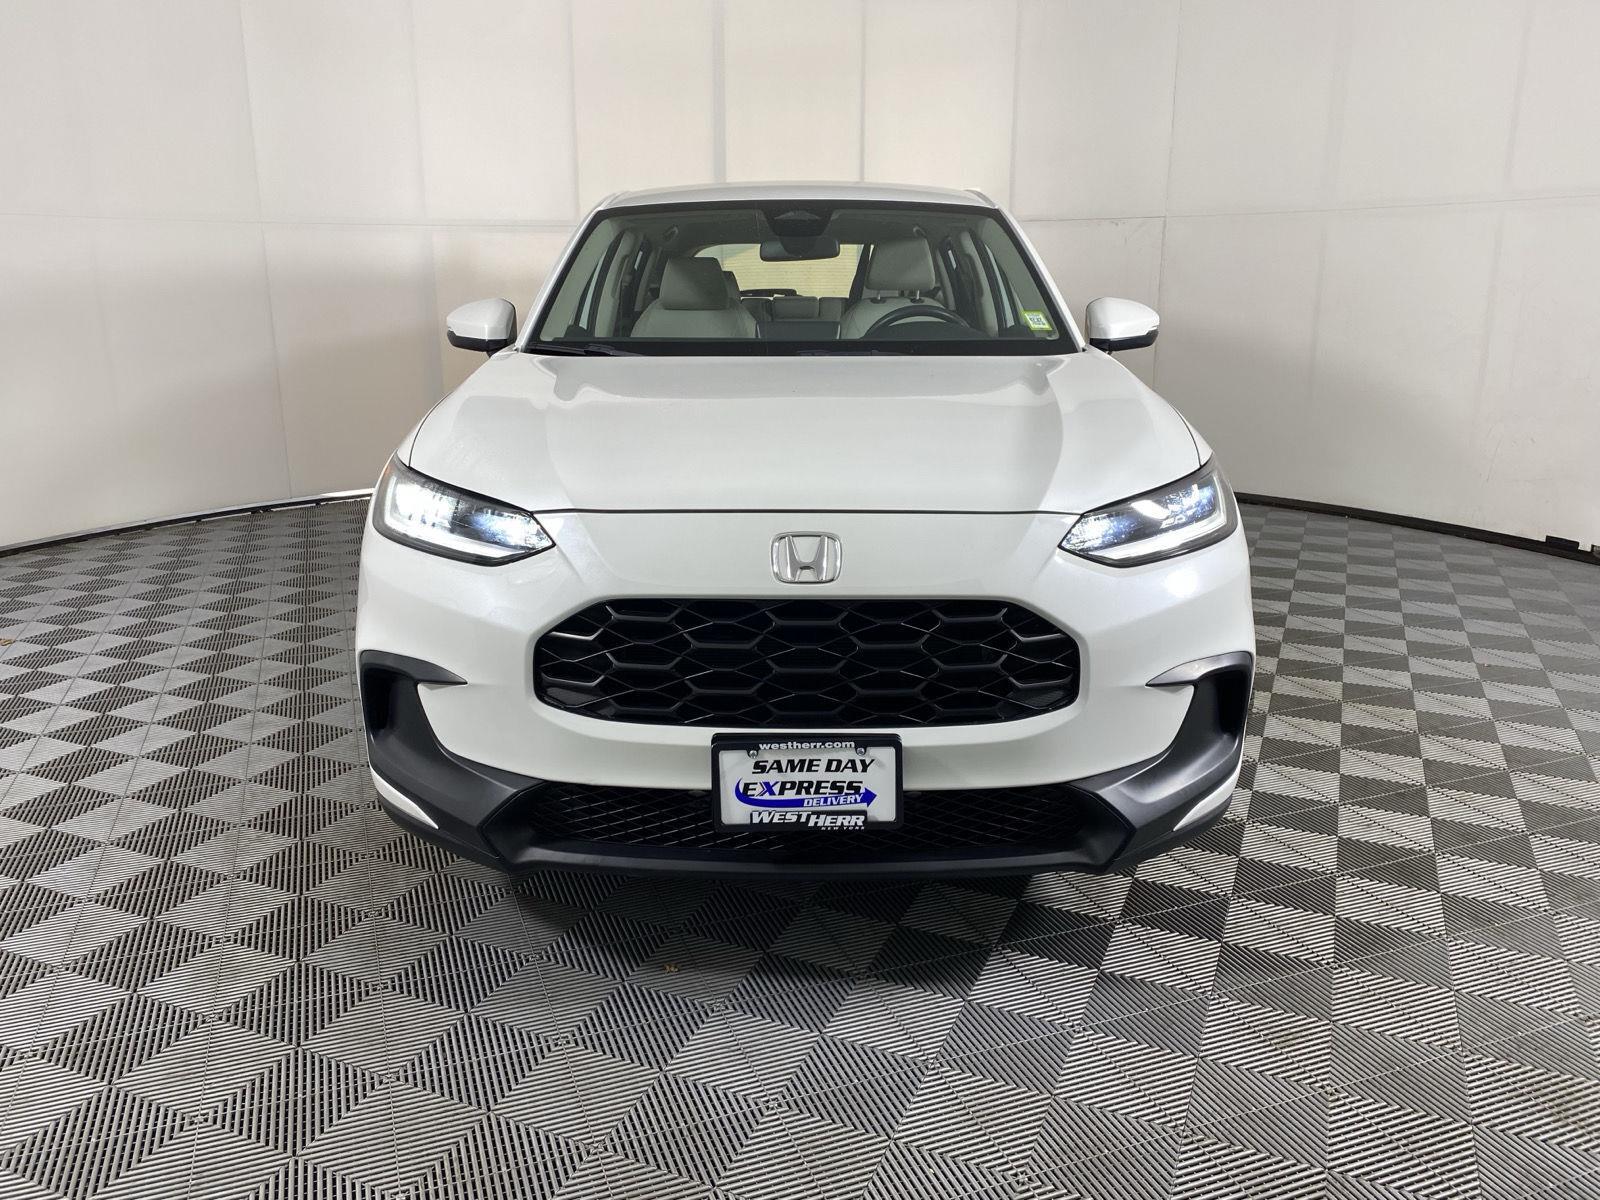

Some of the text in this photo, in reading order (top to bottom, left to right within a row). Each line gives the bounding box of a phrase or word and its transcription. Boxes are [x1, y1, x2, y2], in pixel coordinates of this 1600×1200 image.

[758, 741, 855, 750] westherr.com
[752, 758, 875, 774] SAME DAY
[742, 780, 863, 796] EXPRESS
[803, 793, 864, 807] DELIVERY
